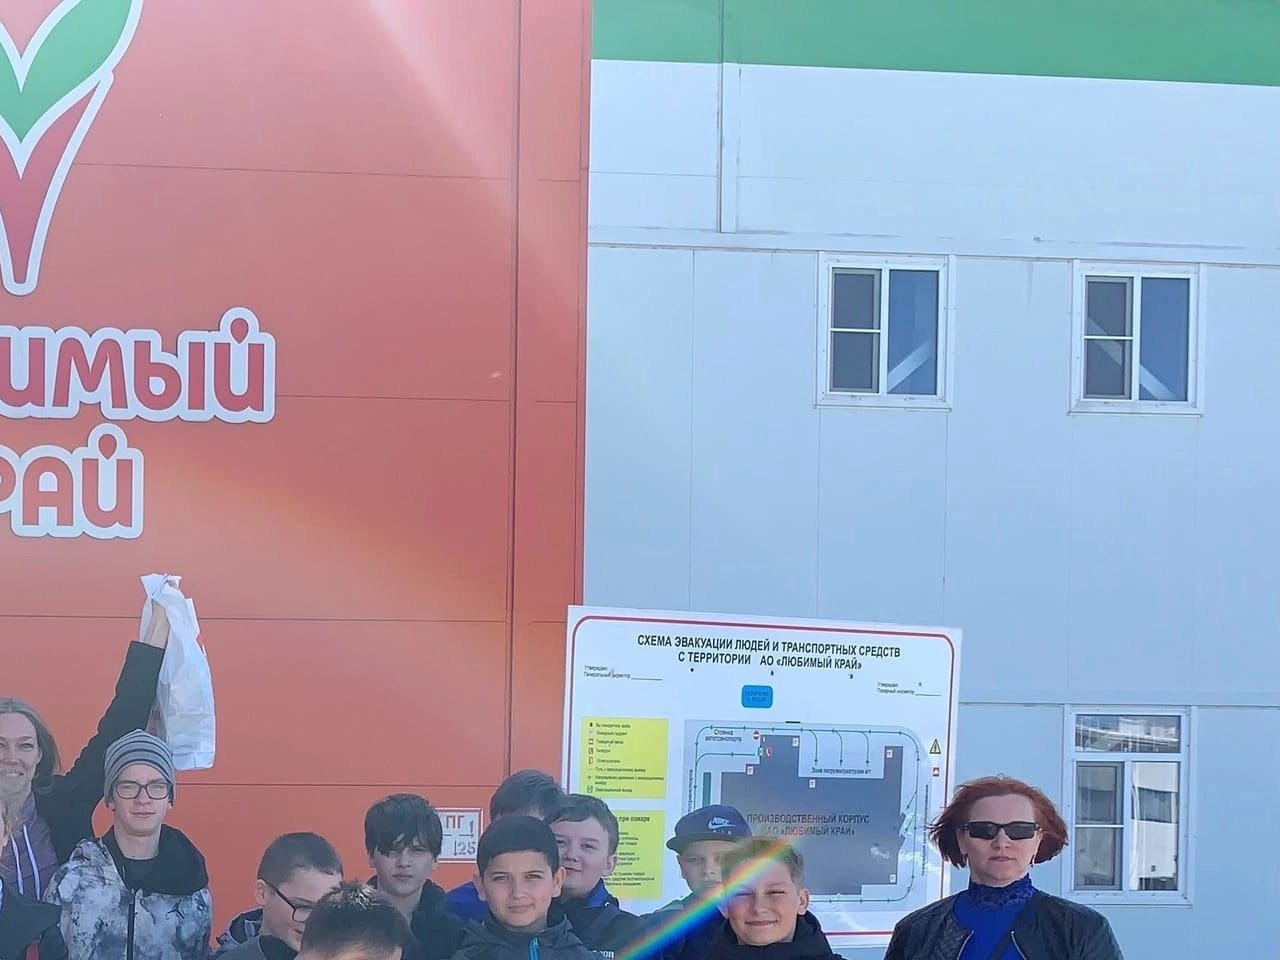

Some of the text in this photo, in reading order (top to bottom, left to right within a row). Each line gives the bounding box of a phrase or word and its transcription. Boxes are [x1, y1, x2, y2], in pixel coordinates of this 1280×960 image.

[637, 634, 901, 658] СХЕМА ЭВАКУАЦИИ ЛЮДЕЙ И ТРАНСПОРТНЫХ СРЕДСТВ
[678, 651, 862, 670] С ТЕРРИТОРИИ АО «ЛЮБИМЫЙ КРАЙ»
[446, 815, 464, 829] ПГ
[746, 813, 870, 824] ПРОИЗВОДСТВЕННЫЙ КОРПУС
[458, 841, 476, 855] 25
